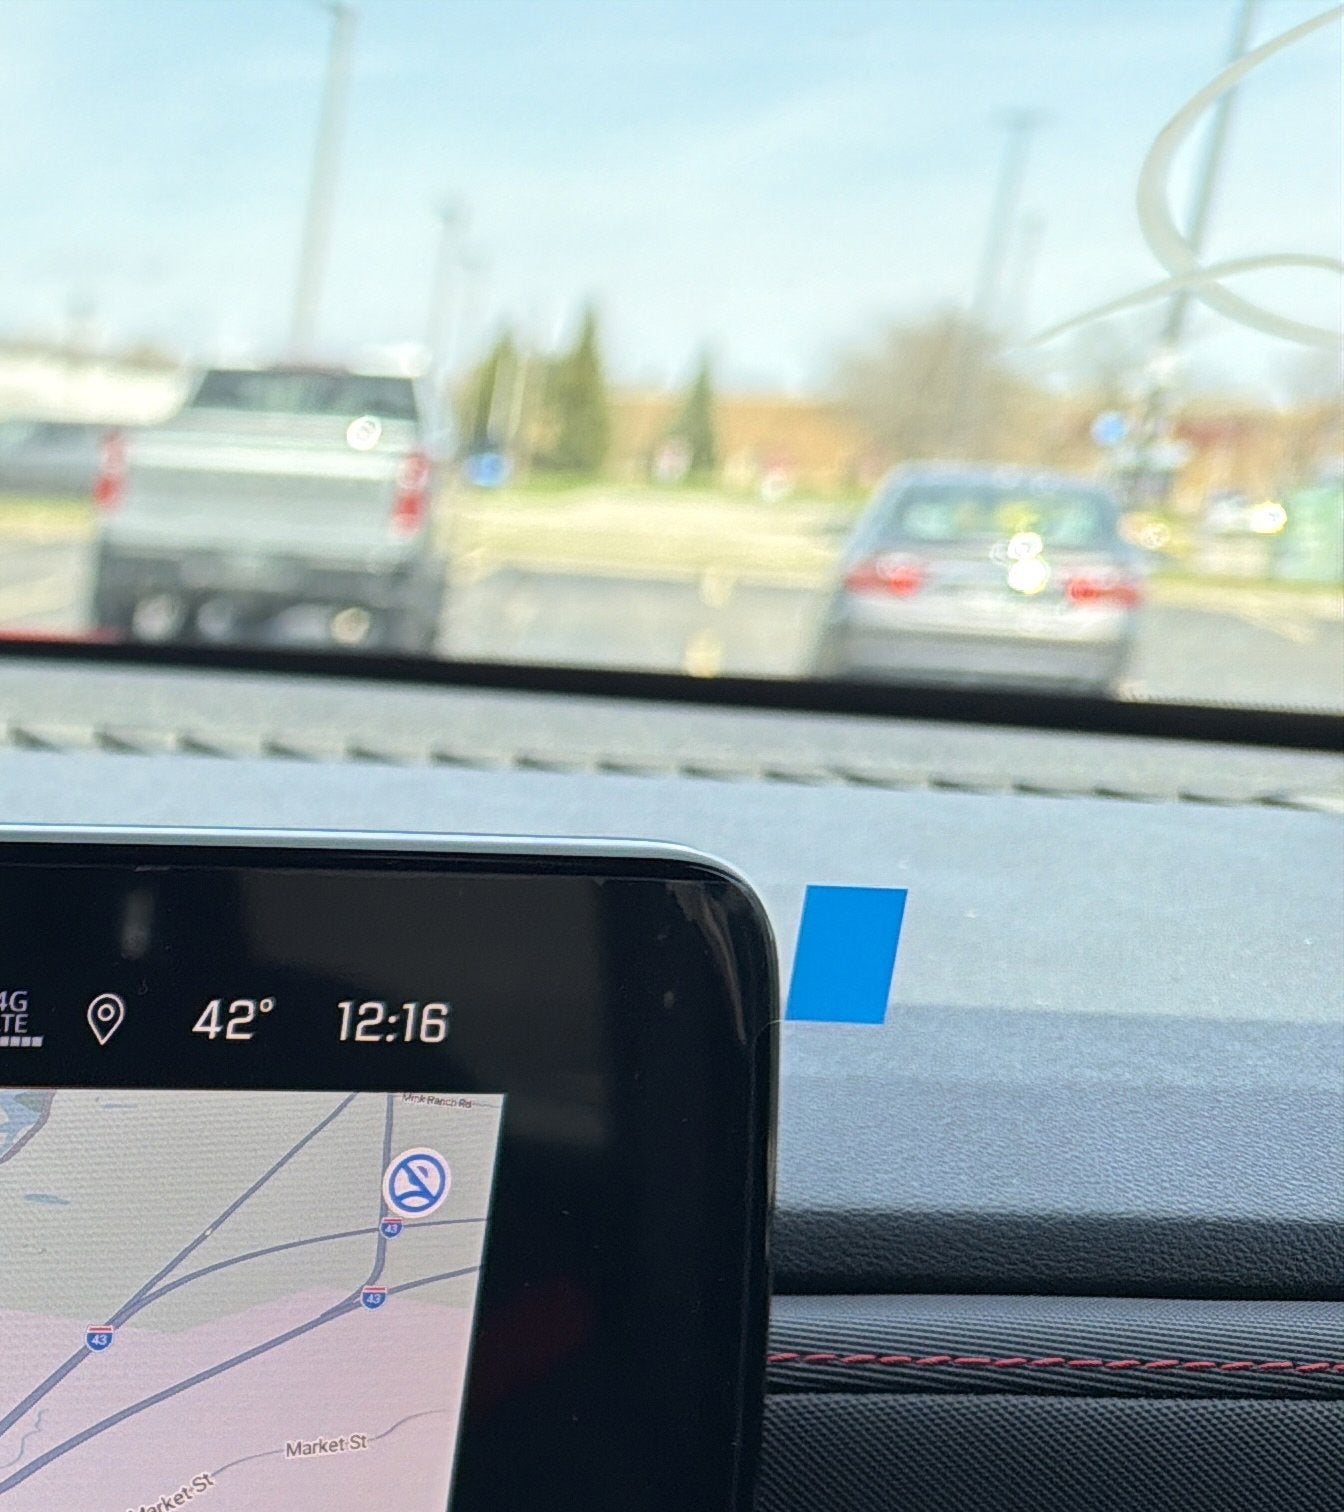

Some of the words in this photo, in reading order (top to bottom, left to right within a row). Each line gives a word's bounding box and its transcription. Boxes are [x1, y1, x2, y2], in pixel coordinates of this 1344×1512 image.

[192, 998, 277, 1041] 42°
[337, 1001, 450, 1043] 12:16
[459, 1098, 472, 1109] Rd
[286, 1437, 345, 1458] Market
[349, 1434, 368, 1449] St
[192, 1473, 214, 1495] St
